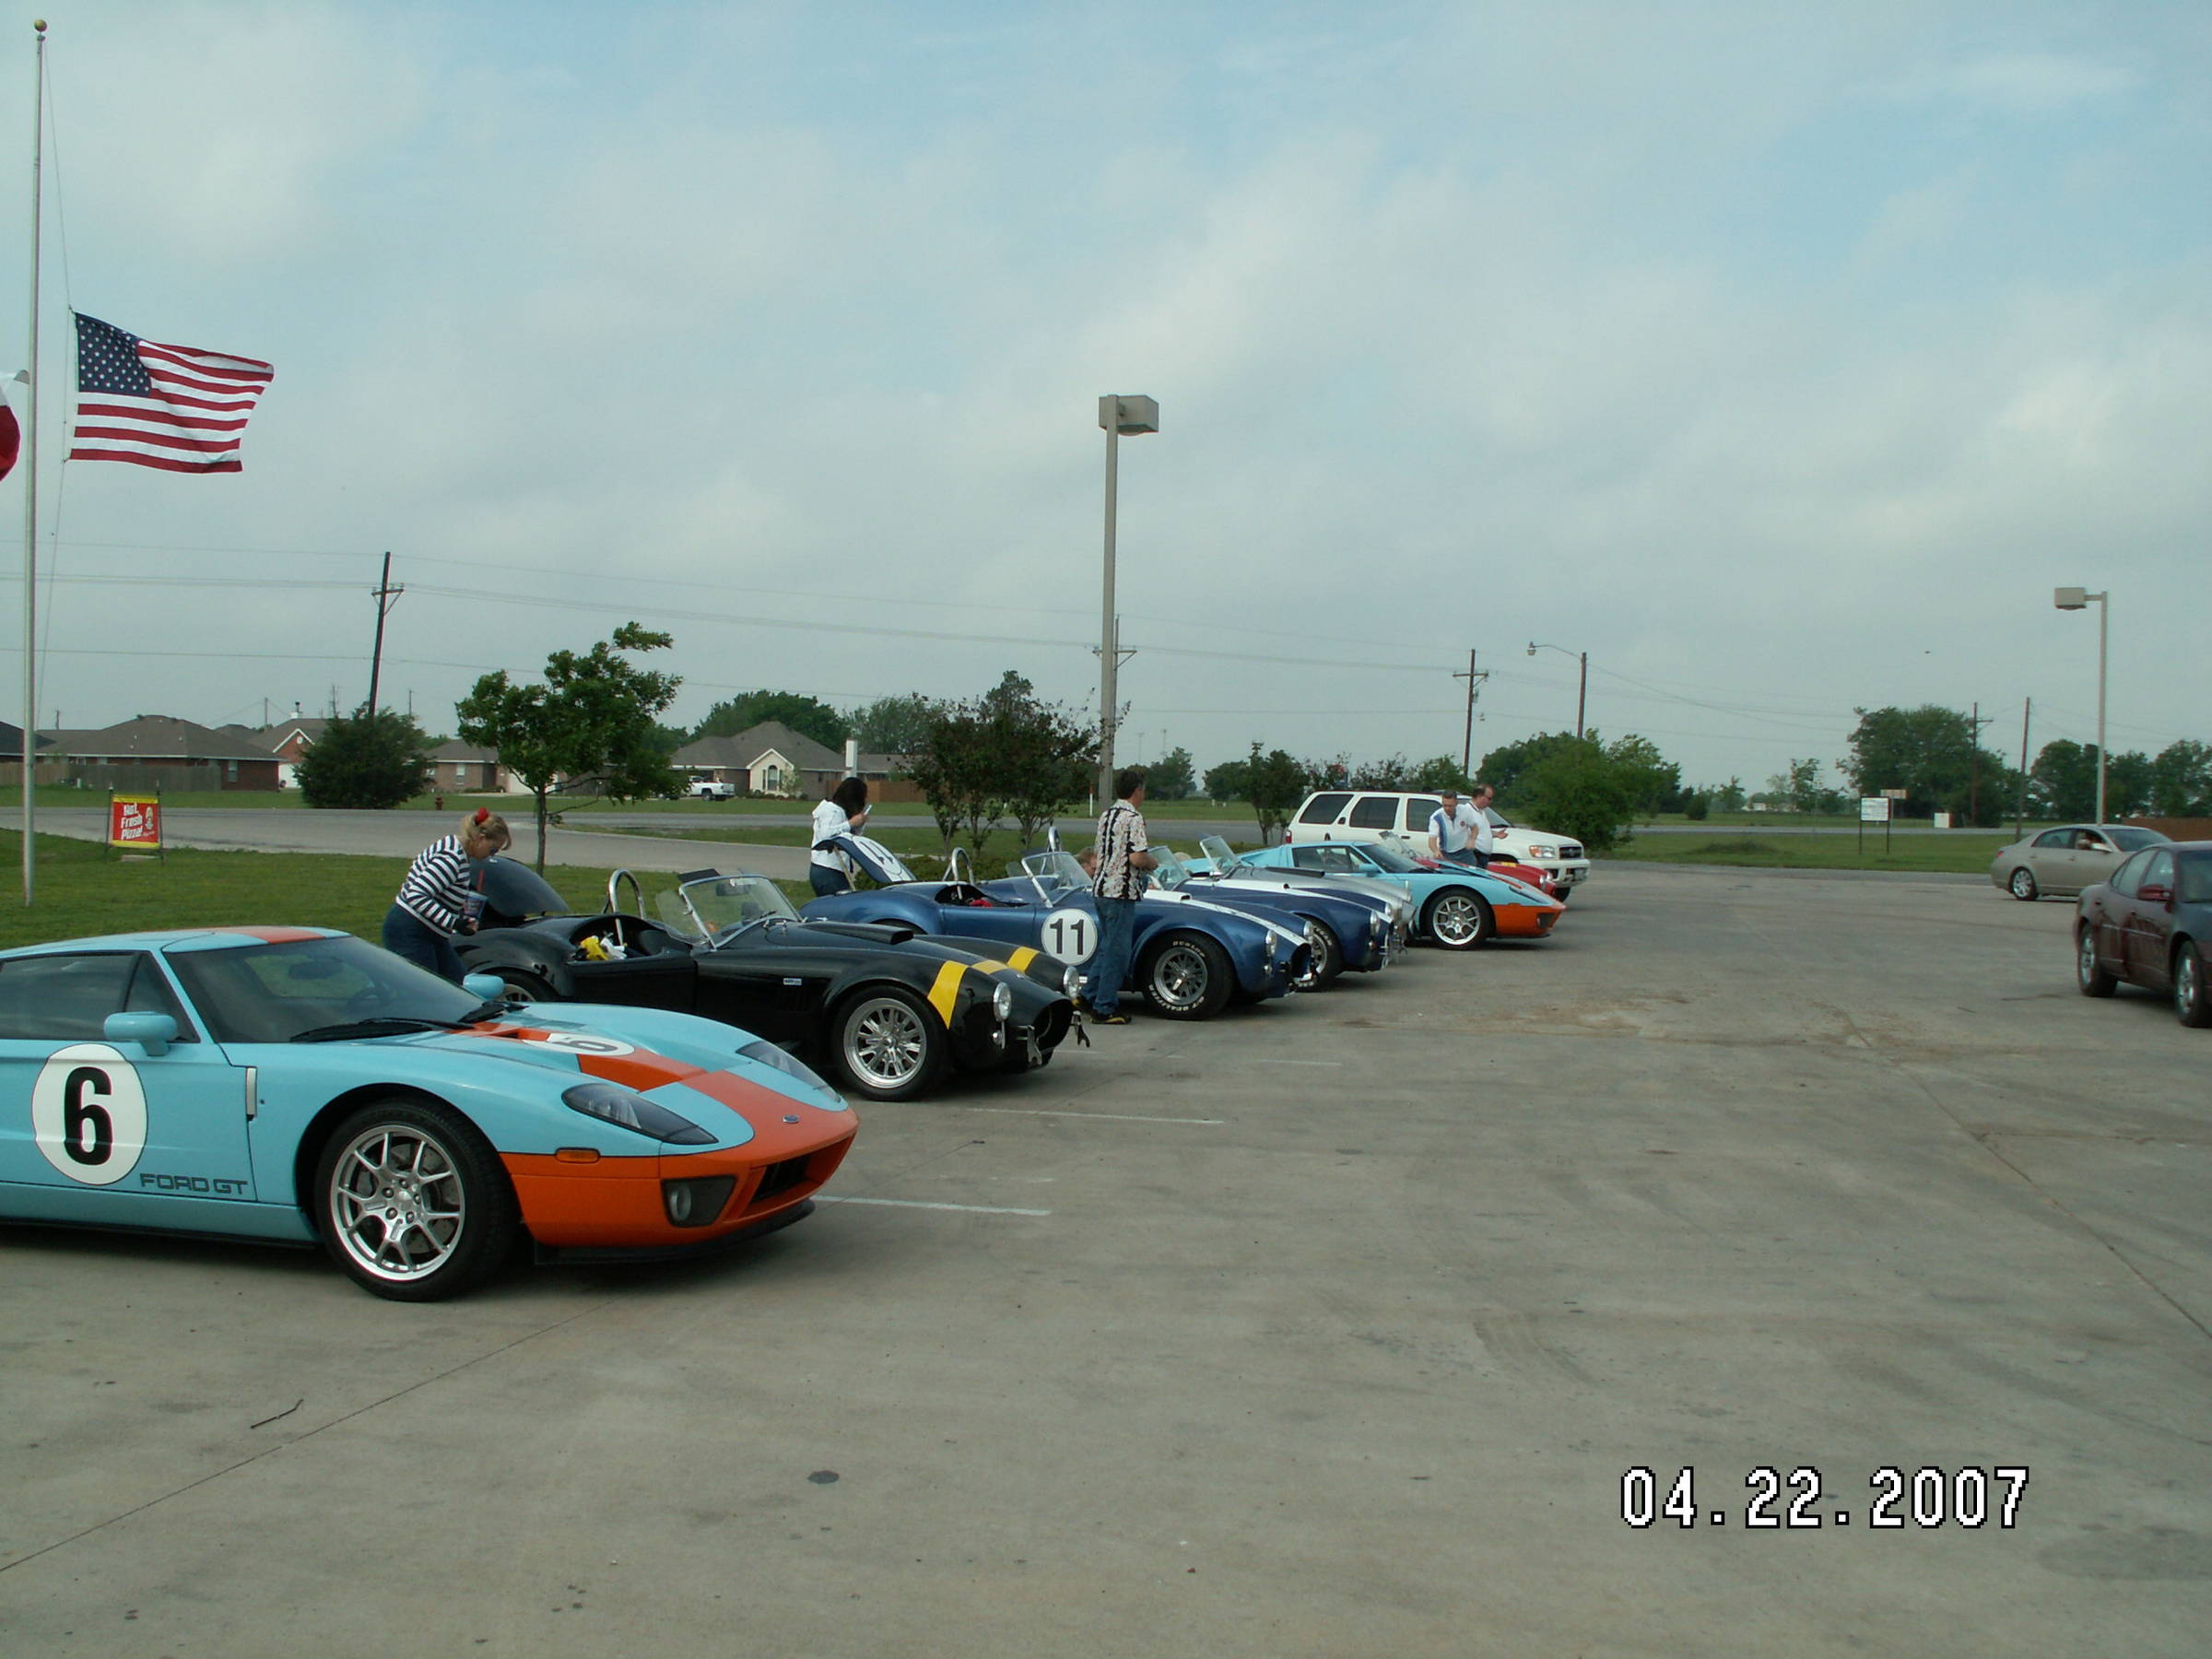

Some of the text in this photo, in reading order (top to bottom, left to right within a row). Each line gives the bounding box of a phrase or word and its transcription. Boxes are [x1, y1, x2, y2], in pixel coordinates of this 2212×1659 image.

[121, 814, 143, 829] Fresh
[1049, 918, 1084, 955] 11
[65, 1066, 112, 1166] 6
[139, 1172, 249, 1195] FORD GT
